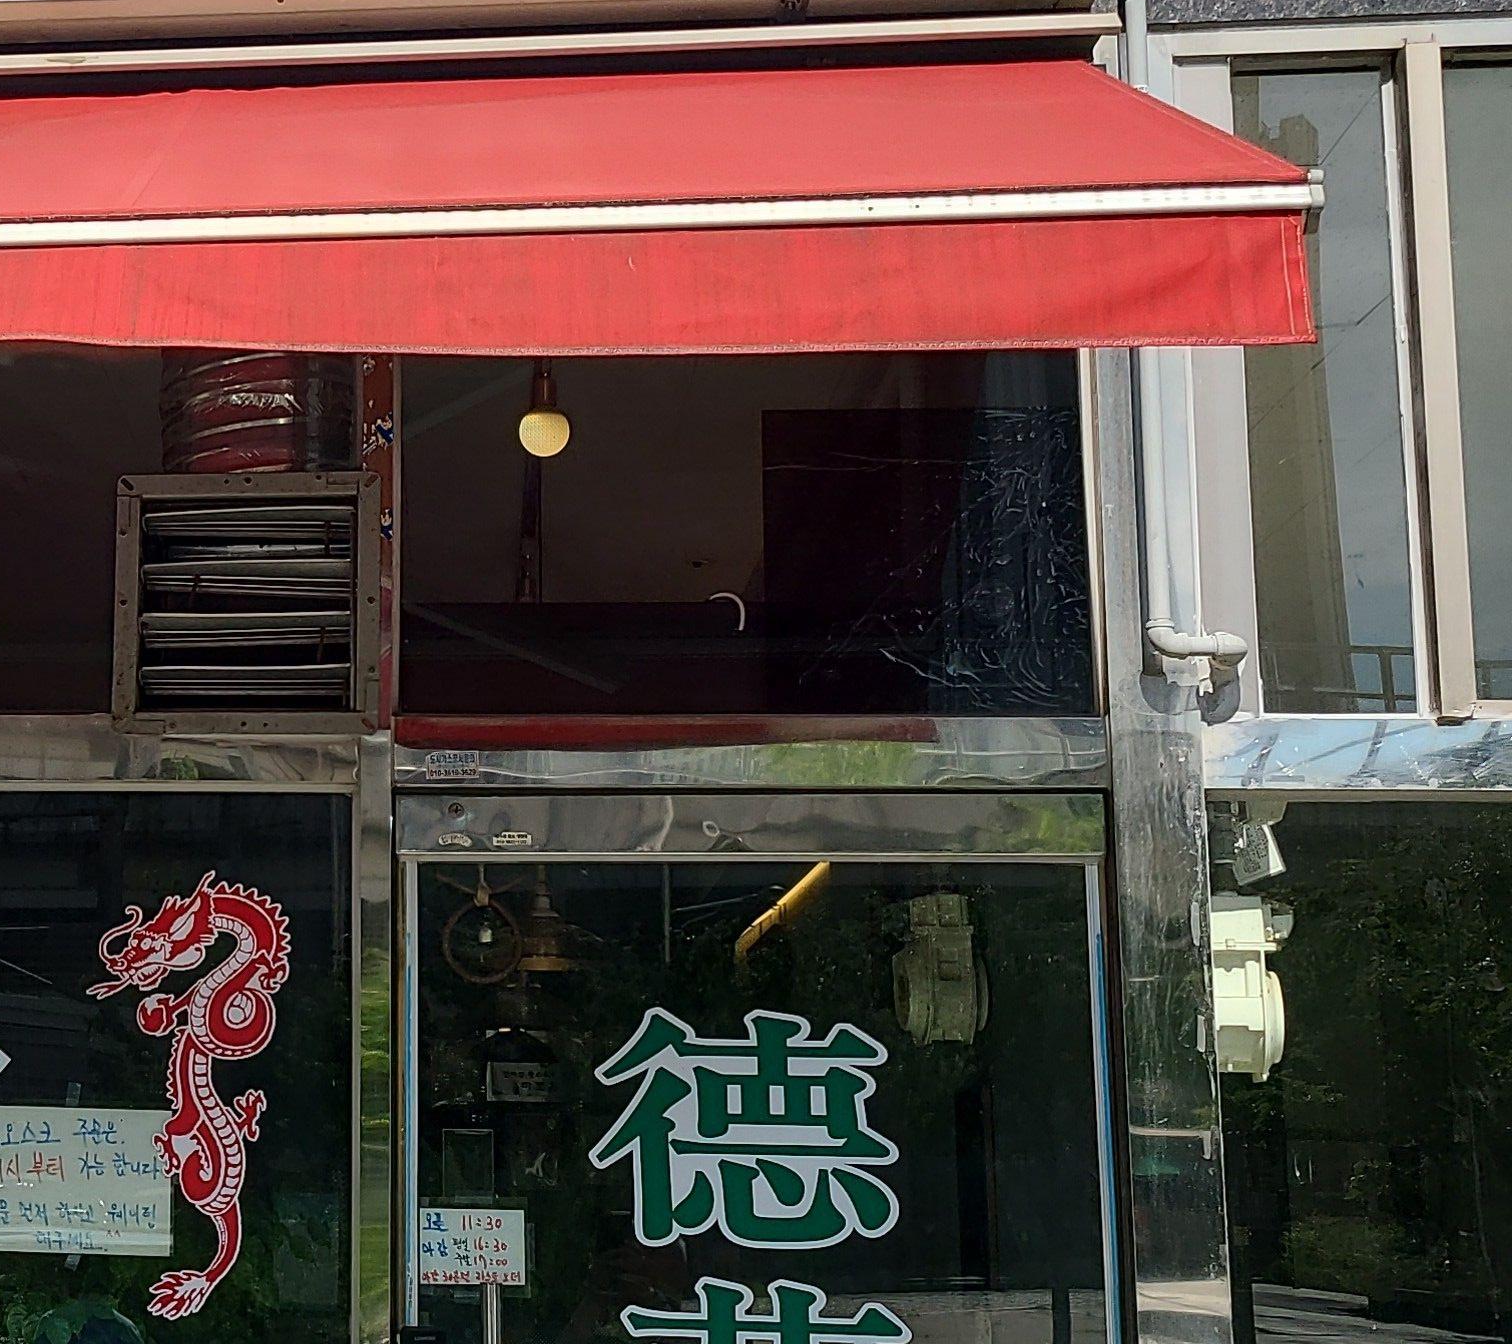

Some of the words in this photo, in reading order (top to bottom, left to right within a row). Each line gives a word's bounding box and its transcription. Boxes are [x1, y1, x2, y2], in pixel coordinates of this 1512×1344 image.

[462, 1214, 503, 1231] 11:30
[422, 1238, 449, 1257] 마감
[473, 1236, 508, 1253] 16:30
[473, 1254, 508, 1269] 17:00
